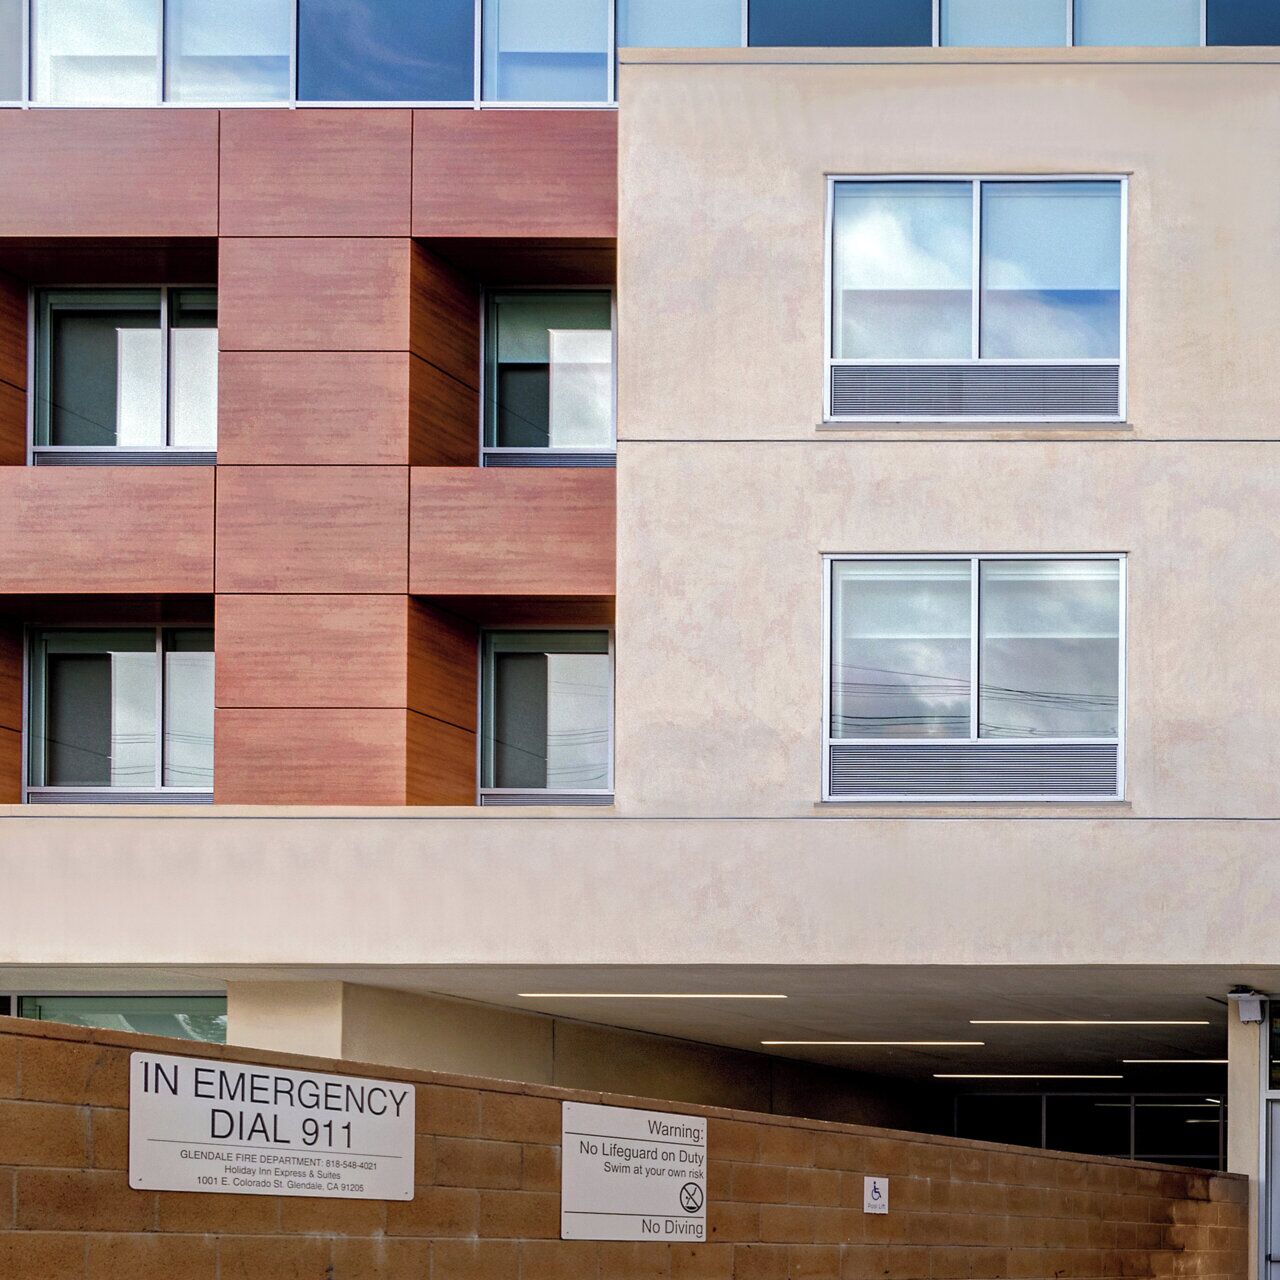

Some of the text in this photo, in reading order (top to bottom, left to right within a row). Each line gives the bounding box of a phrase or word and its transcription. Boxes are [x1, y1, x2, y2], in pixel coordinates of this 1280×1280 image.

[143, 1061, 409, 1117] IN EMERGENCY
[210, 1108, 352, 1149] DIAL 911
[648, 1120, 704, 1142] Warning:
[180, 1149, 233, 1162] GLENDALE
[235, 1153, 257, 1163] FIRE
[580, 1140, 704, 1167] No Lifeguard on Duty
[224, 1165, 341, 1180] Holiday Inn Express & Suites
[604, 1161, 704, 1179] Swim at your own risk
[197, 1176, 218, 1186] 1001
[232, 1178, 271, 1188] Colorado
[326, 1182, 339, 1191] CA
[340, 1183, 364, 1192] 91205
[642, 1219, 704, 1238] No Diving
